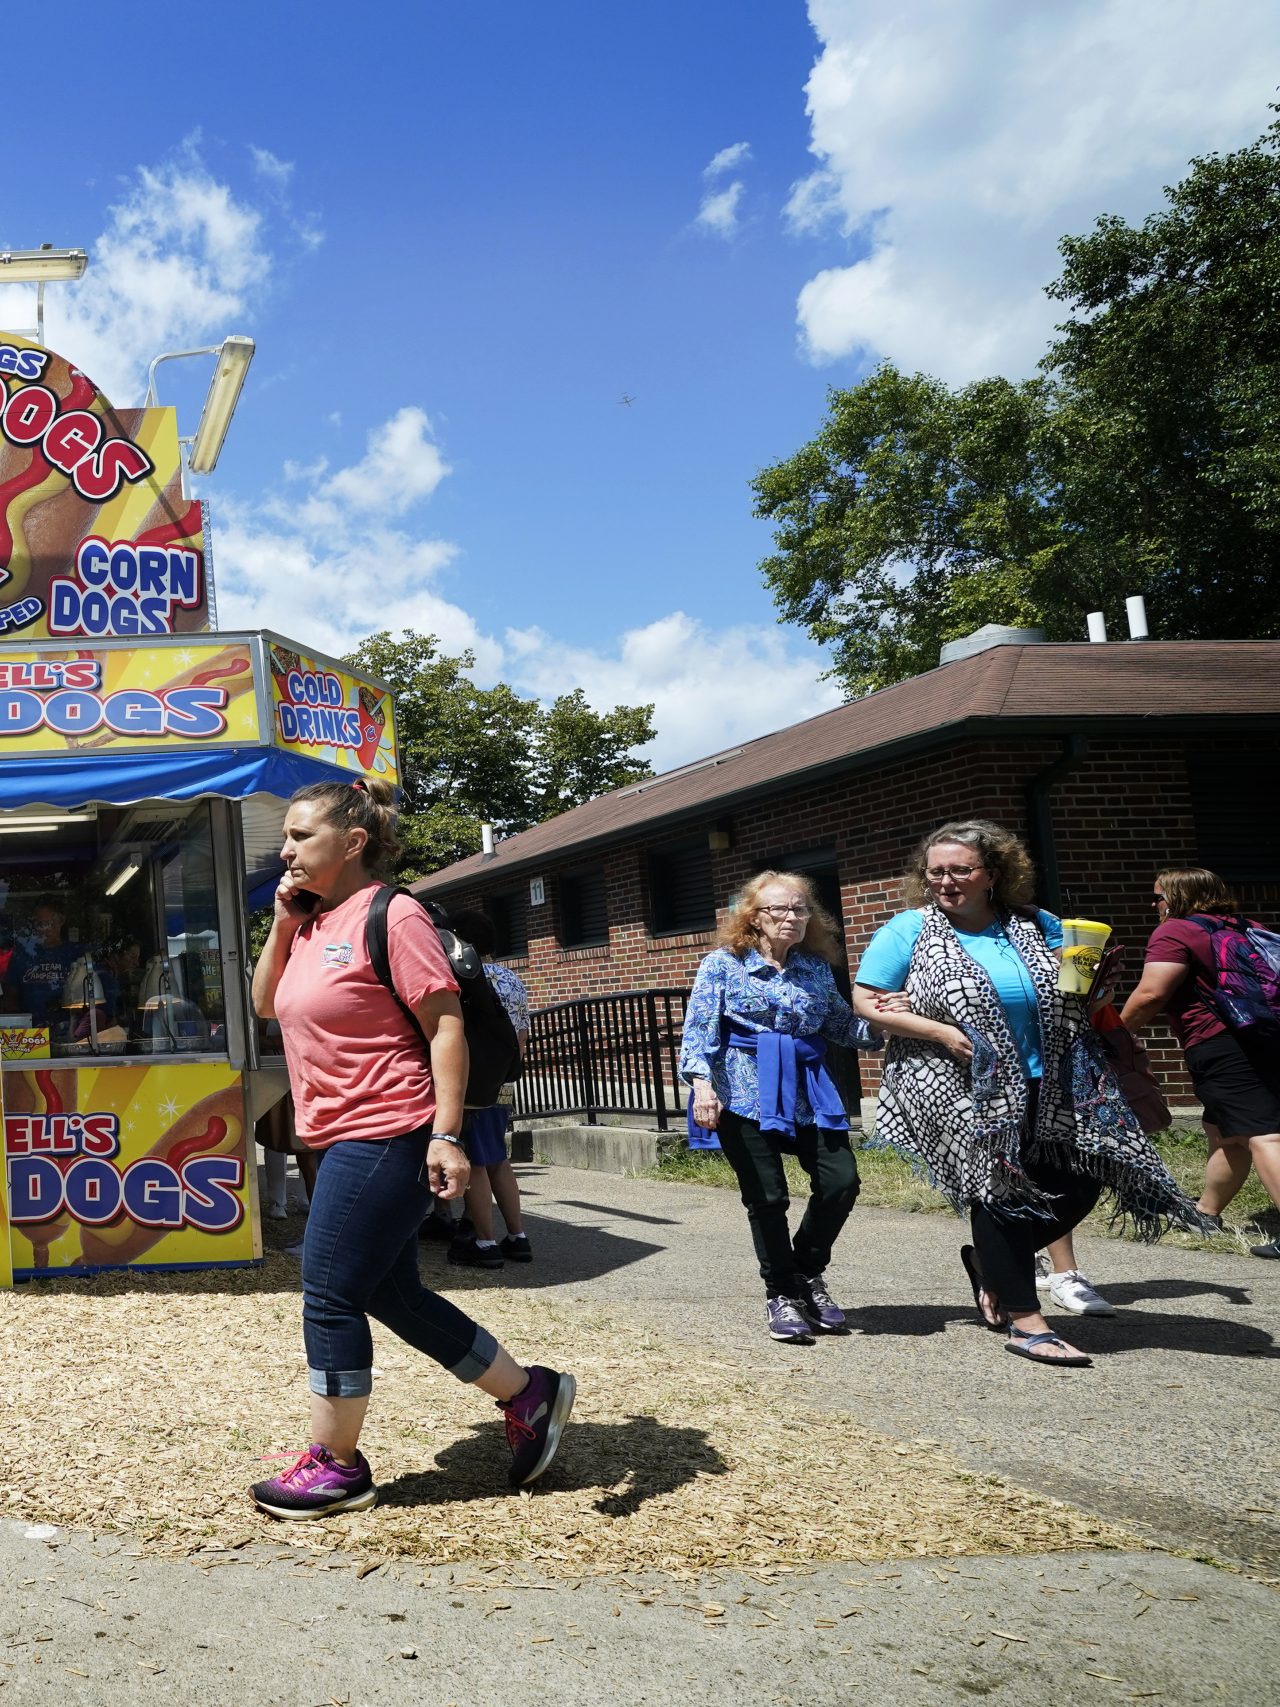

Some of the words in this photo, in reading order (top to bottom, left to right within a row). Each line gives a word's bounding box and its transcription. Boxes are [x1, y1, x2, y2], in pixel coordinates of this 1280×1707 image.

[79, 541, 200, 606] CORN
[51, 580, 172, 635] DOGS
[288, 672, 342, 706] COLD
[279, 703, 362, 747] DRINKS
[531, 882, 543, 901] 11
[39, 963, 62, 971] TEAM
[22, 1037, 46, 1045] DOGS
[9, 1156, 243, 1231] DOGS
